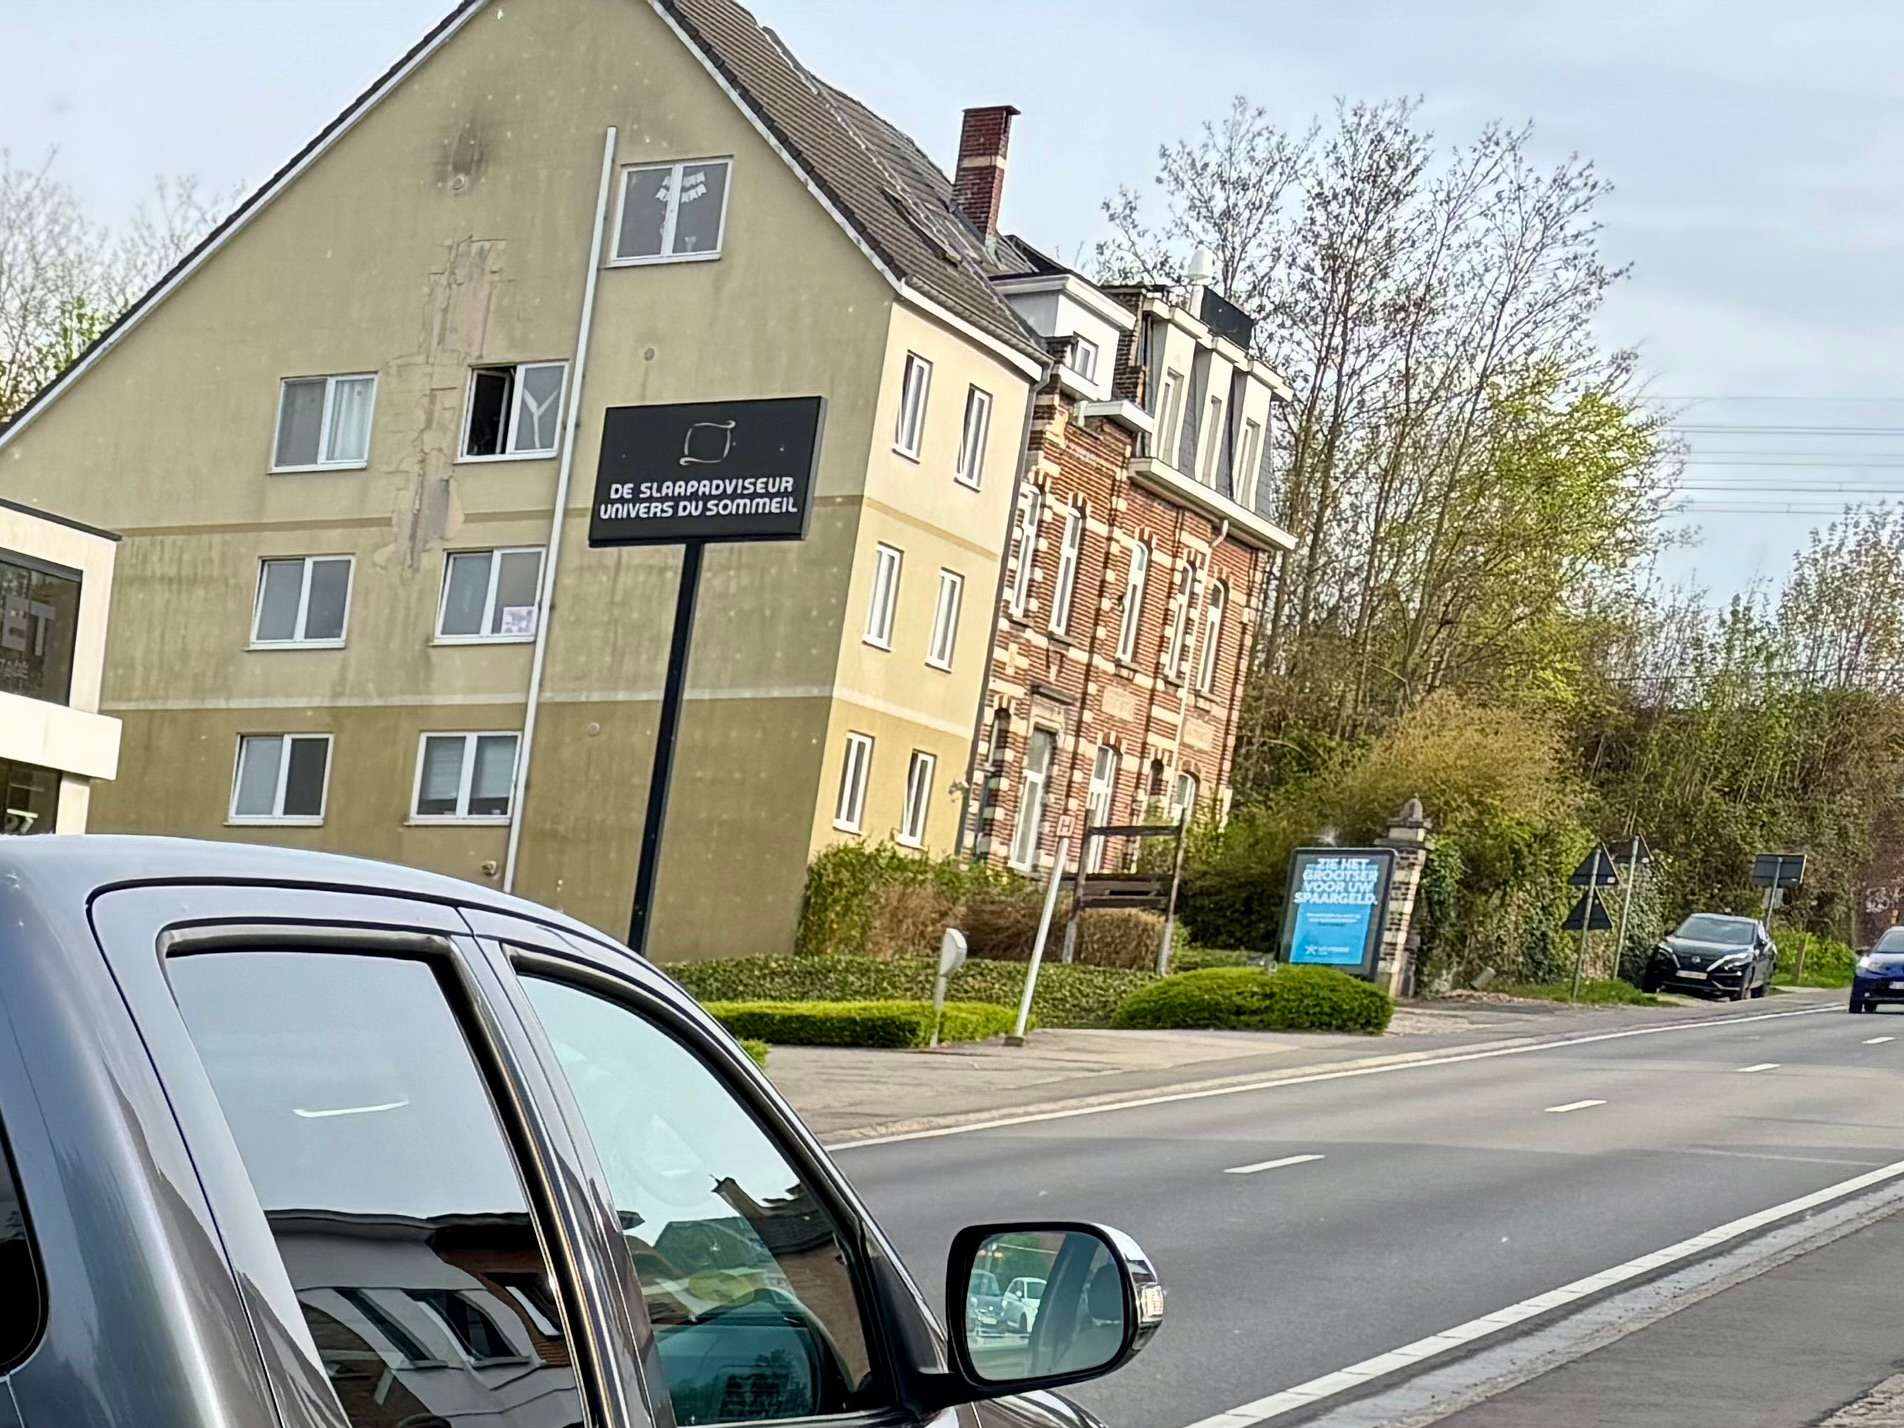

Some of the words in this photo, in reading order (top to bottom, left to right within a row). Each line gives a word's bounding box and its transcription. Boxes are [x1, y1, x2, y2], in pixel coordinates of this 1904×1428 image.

[610, 483, 634, 500] DE
[639, 476, 794, 498] SLAAPADVISEUR
[600, 501, 673, 520] UNIVERS
[677, 501, 704, 518] DU
[705, 496, 798, 516] SOMMEIL
[1318, 858, 1339, 869] ZIE
[1341, 858, 1370, 869] HET
[1302, 869, 1378, 882] GROOTSER
[1303, 881, 1345, 892] VOOR
[1348, 881, 1376, 892] UW
